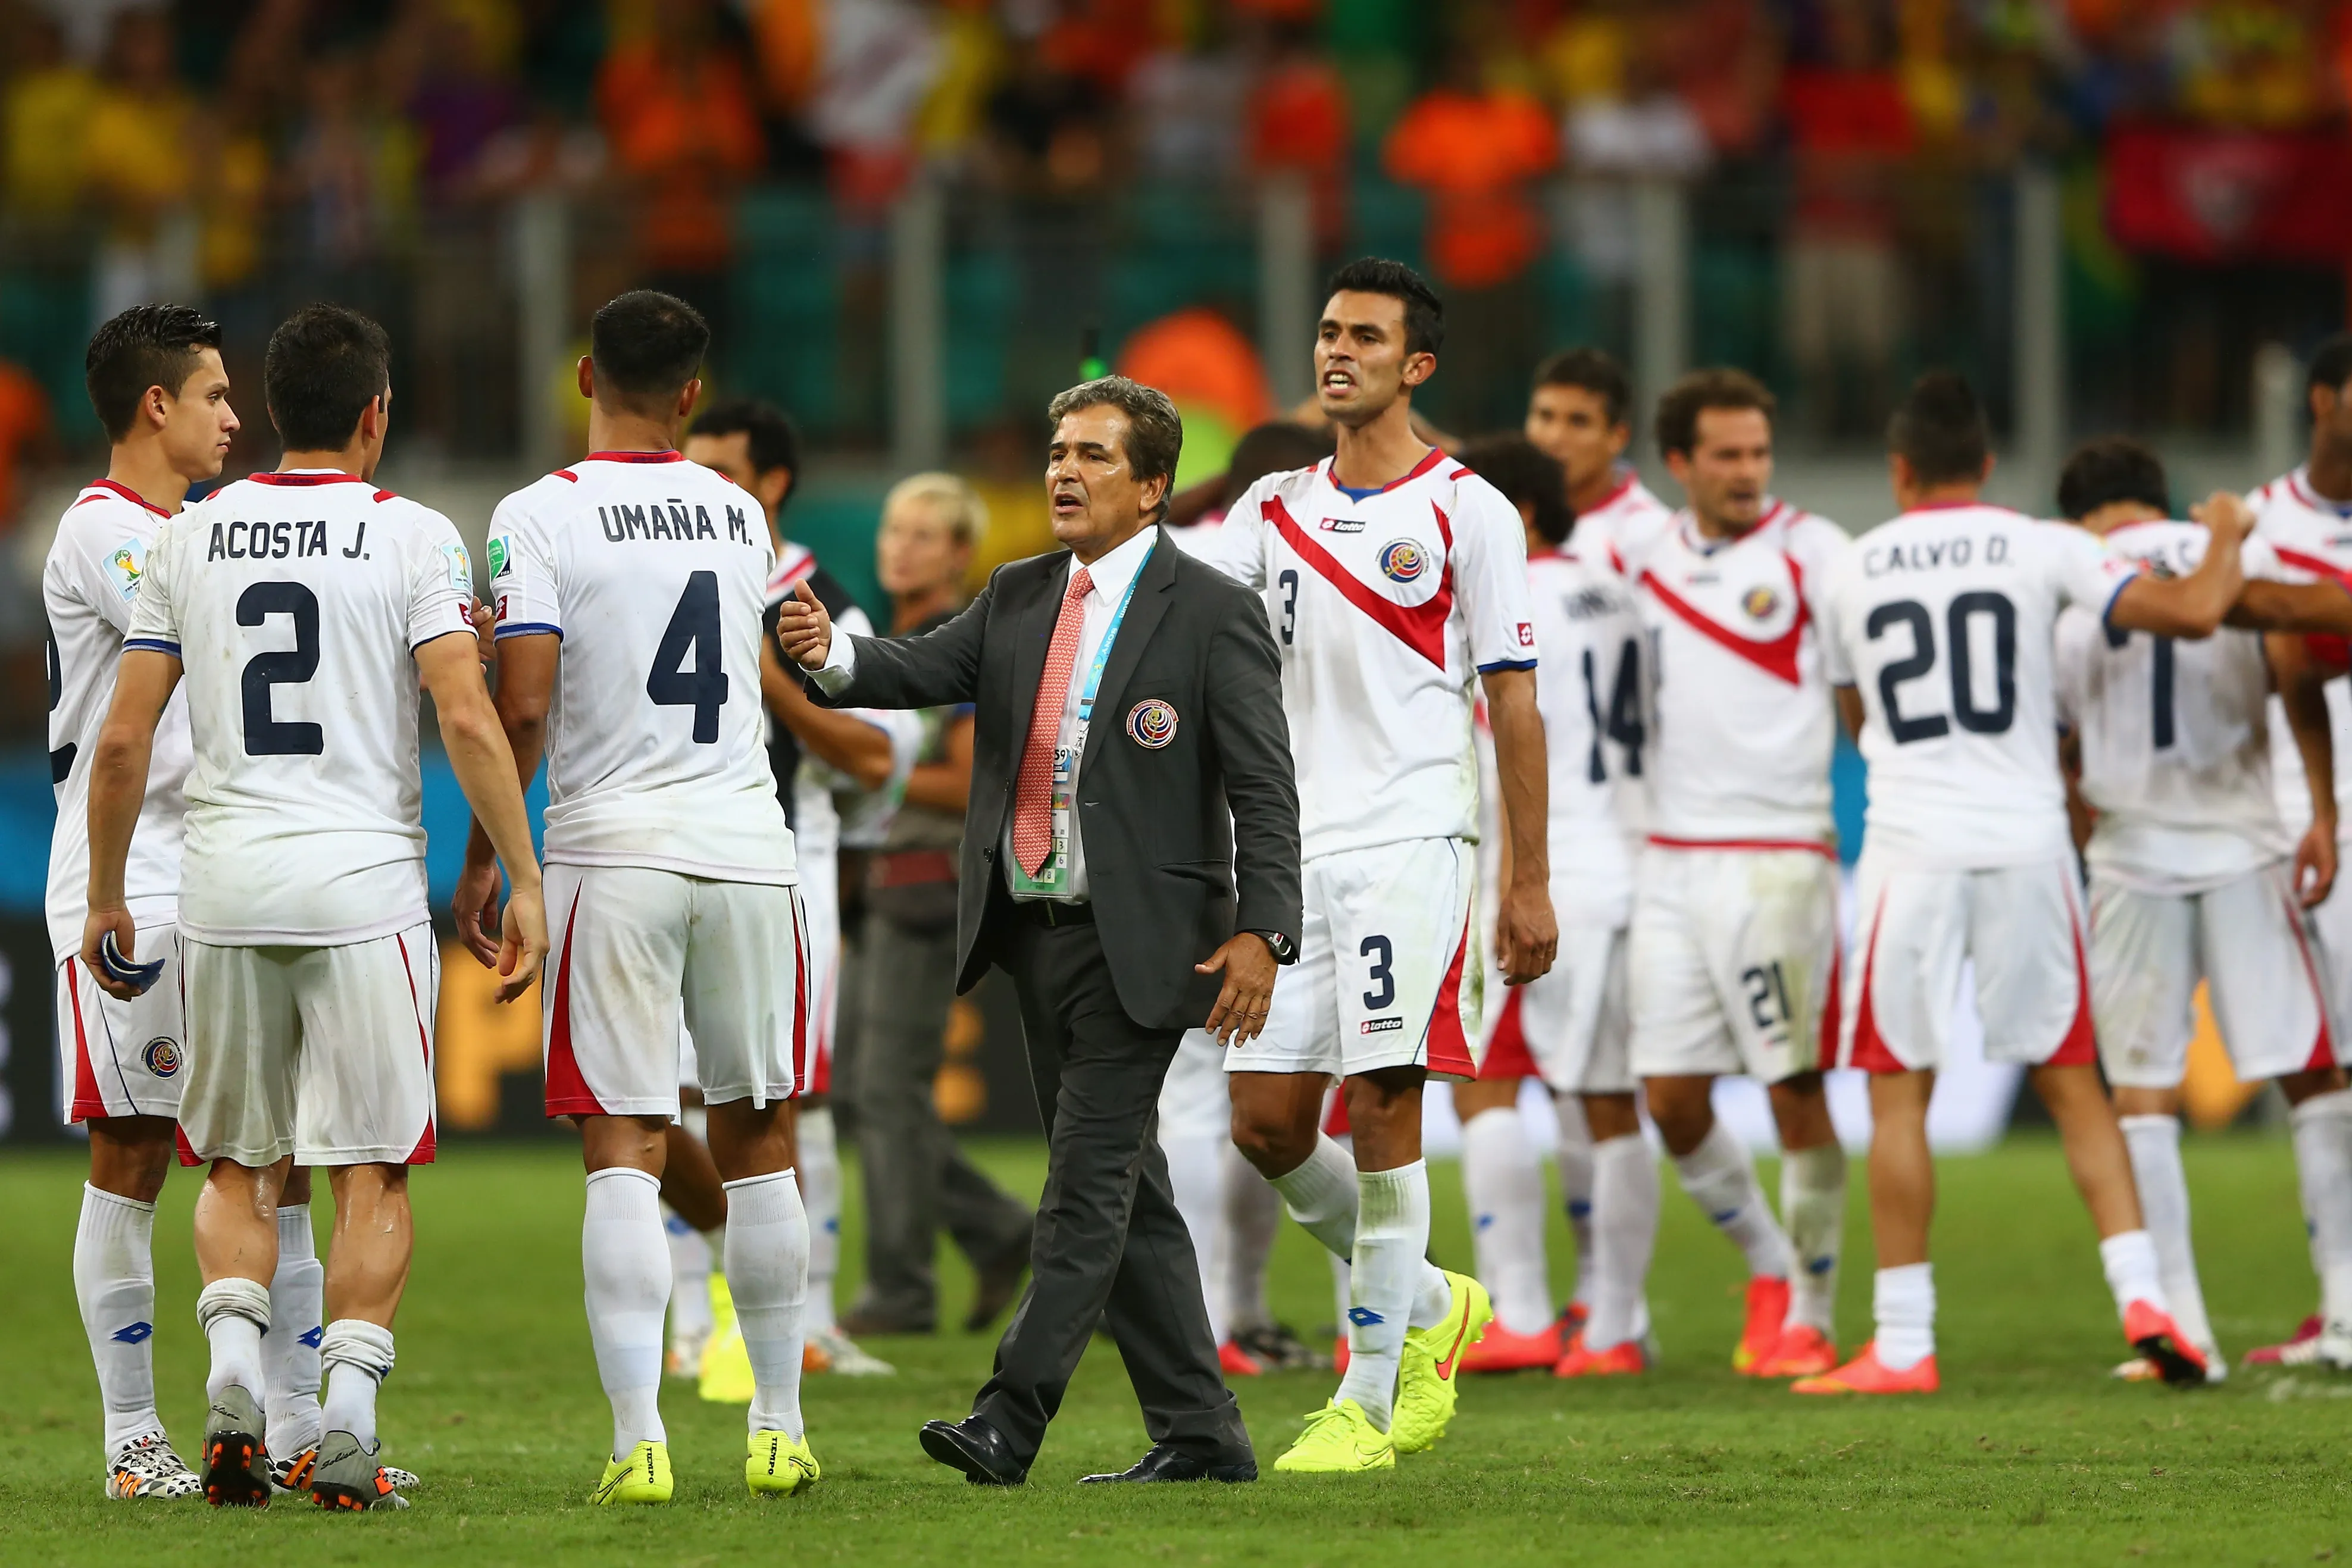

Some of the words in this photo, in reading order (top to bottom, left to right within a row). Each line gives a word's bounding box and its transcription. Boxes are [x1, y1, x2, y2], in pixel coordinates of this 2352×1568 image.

[208, 521, 328, 562] ACOSTA
[342, 522, 370, 561] J.
[598, 498, 717, 543] UMAÑA
[725, 504, 753, 546] M.
[1863, 536, 1973, 581] CALVO
[1102, 627, 1118, 654] SONY
[1279, 568, 1299, 646] 3
[235, 580, 325, 756] 2
[646, 570, 729, 744] 4
[1865, 590, 2018, 744] 20
[1581, 636, 1646, 785] 14
[1059, 856, 1064, 865] 6
[1360, 934, 1395, 1010] 3
[1742, 960, 1794, 1029] 21
[768, 1436, 777, 1476] TIEMPO
